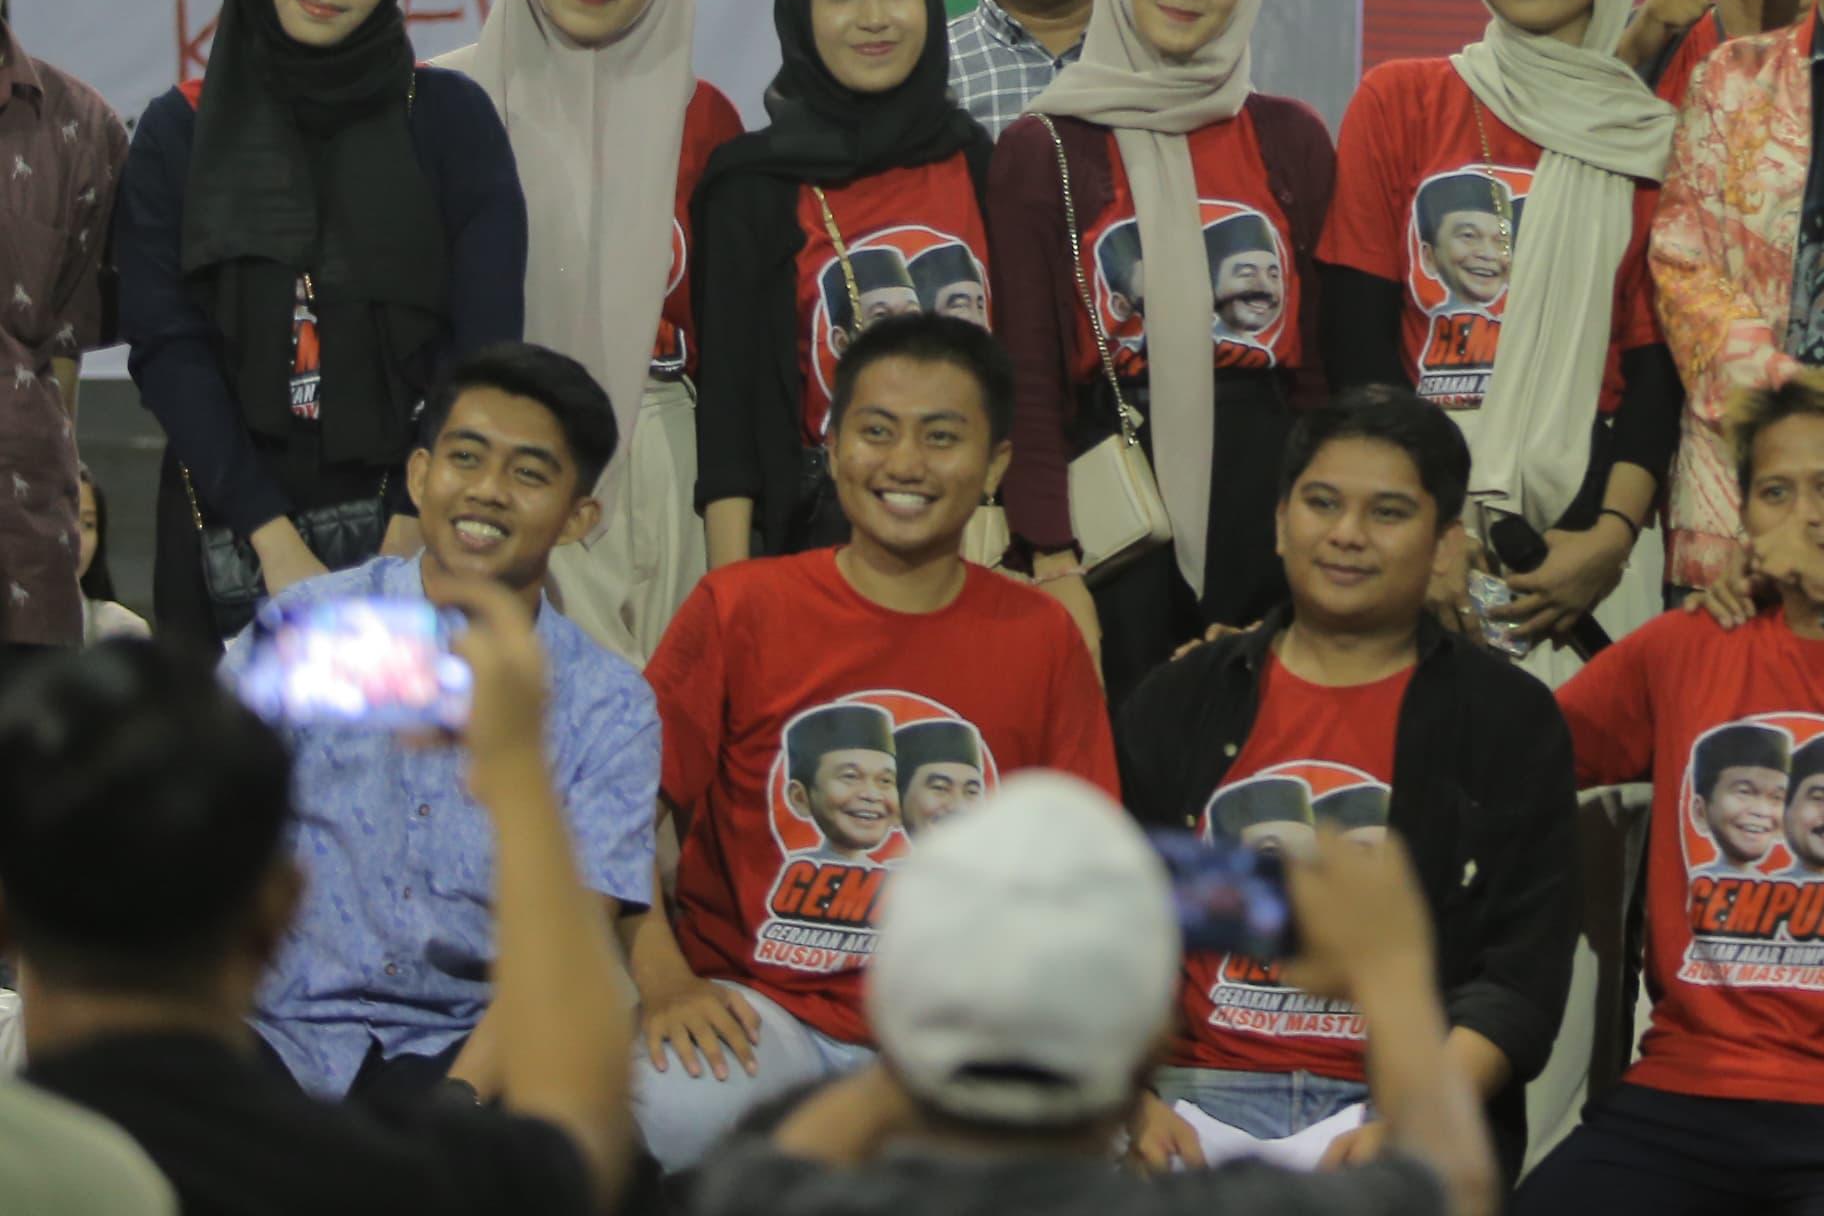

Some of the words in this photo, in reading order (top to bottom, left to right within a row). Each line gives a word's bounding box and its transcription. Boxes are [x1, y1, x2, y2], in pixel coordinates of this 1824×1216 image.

[773, 860, 892, 922] GEM
[760, 940, 840, 969] RUSDY
[1285, 1013, 1367, 1035] MASTU
